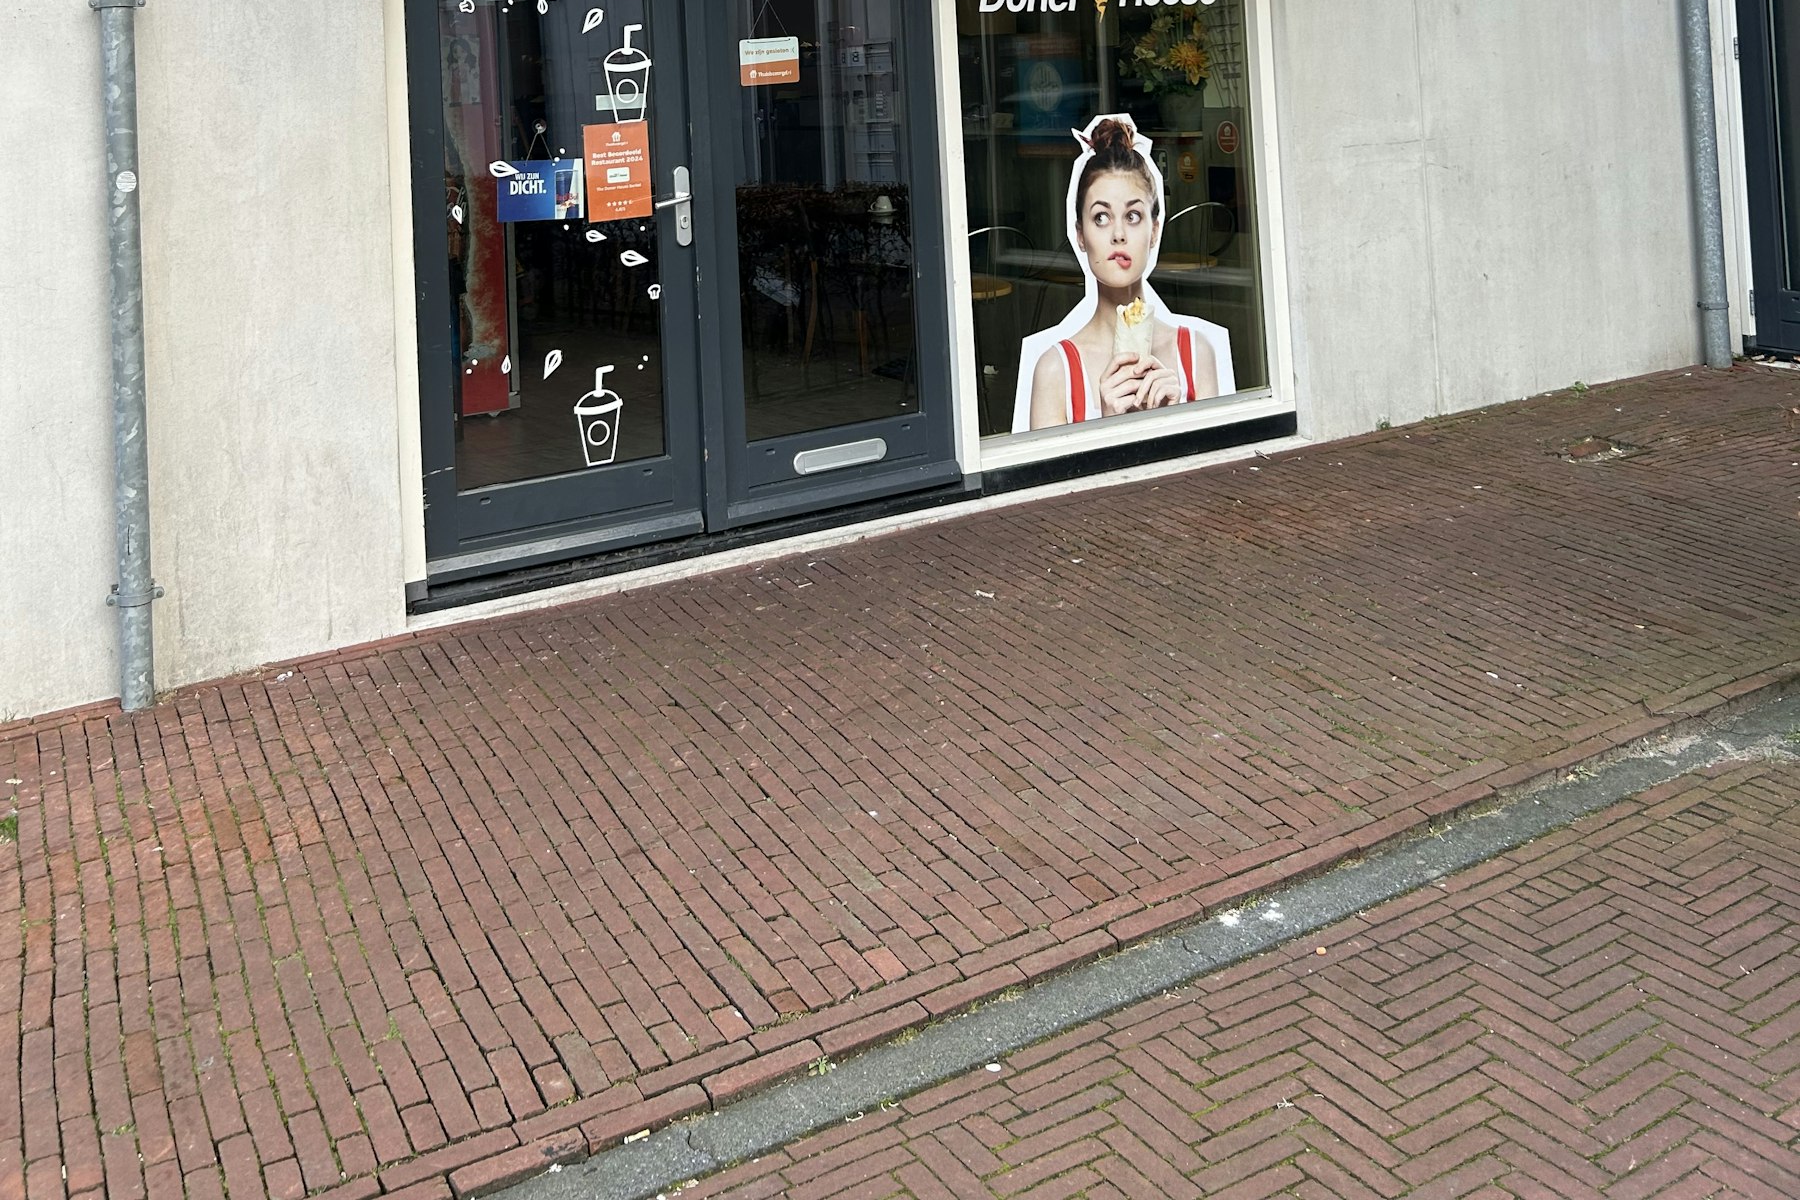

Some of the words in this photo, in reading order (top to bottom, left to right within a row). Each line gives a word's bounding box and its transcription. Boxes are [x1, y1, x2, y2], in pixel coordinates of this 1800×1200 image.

[591, 157, 626, 166] Restaurant
[626, 155, 644, 163] 2024
[514, 172, 526, 181] WIJ
[509, 179, 547, 196] DICHT.
